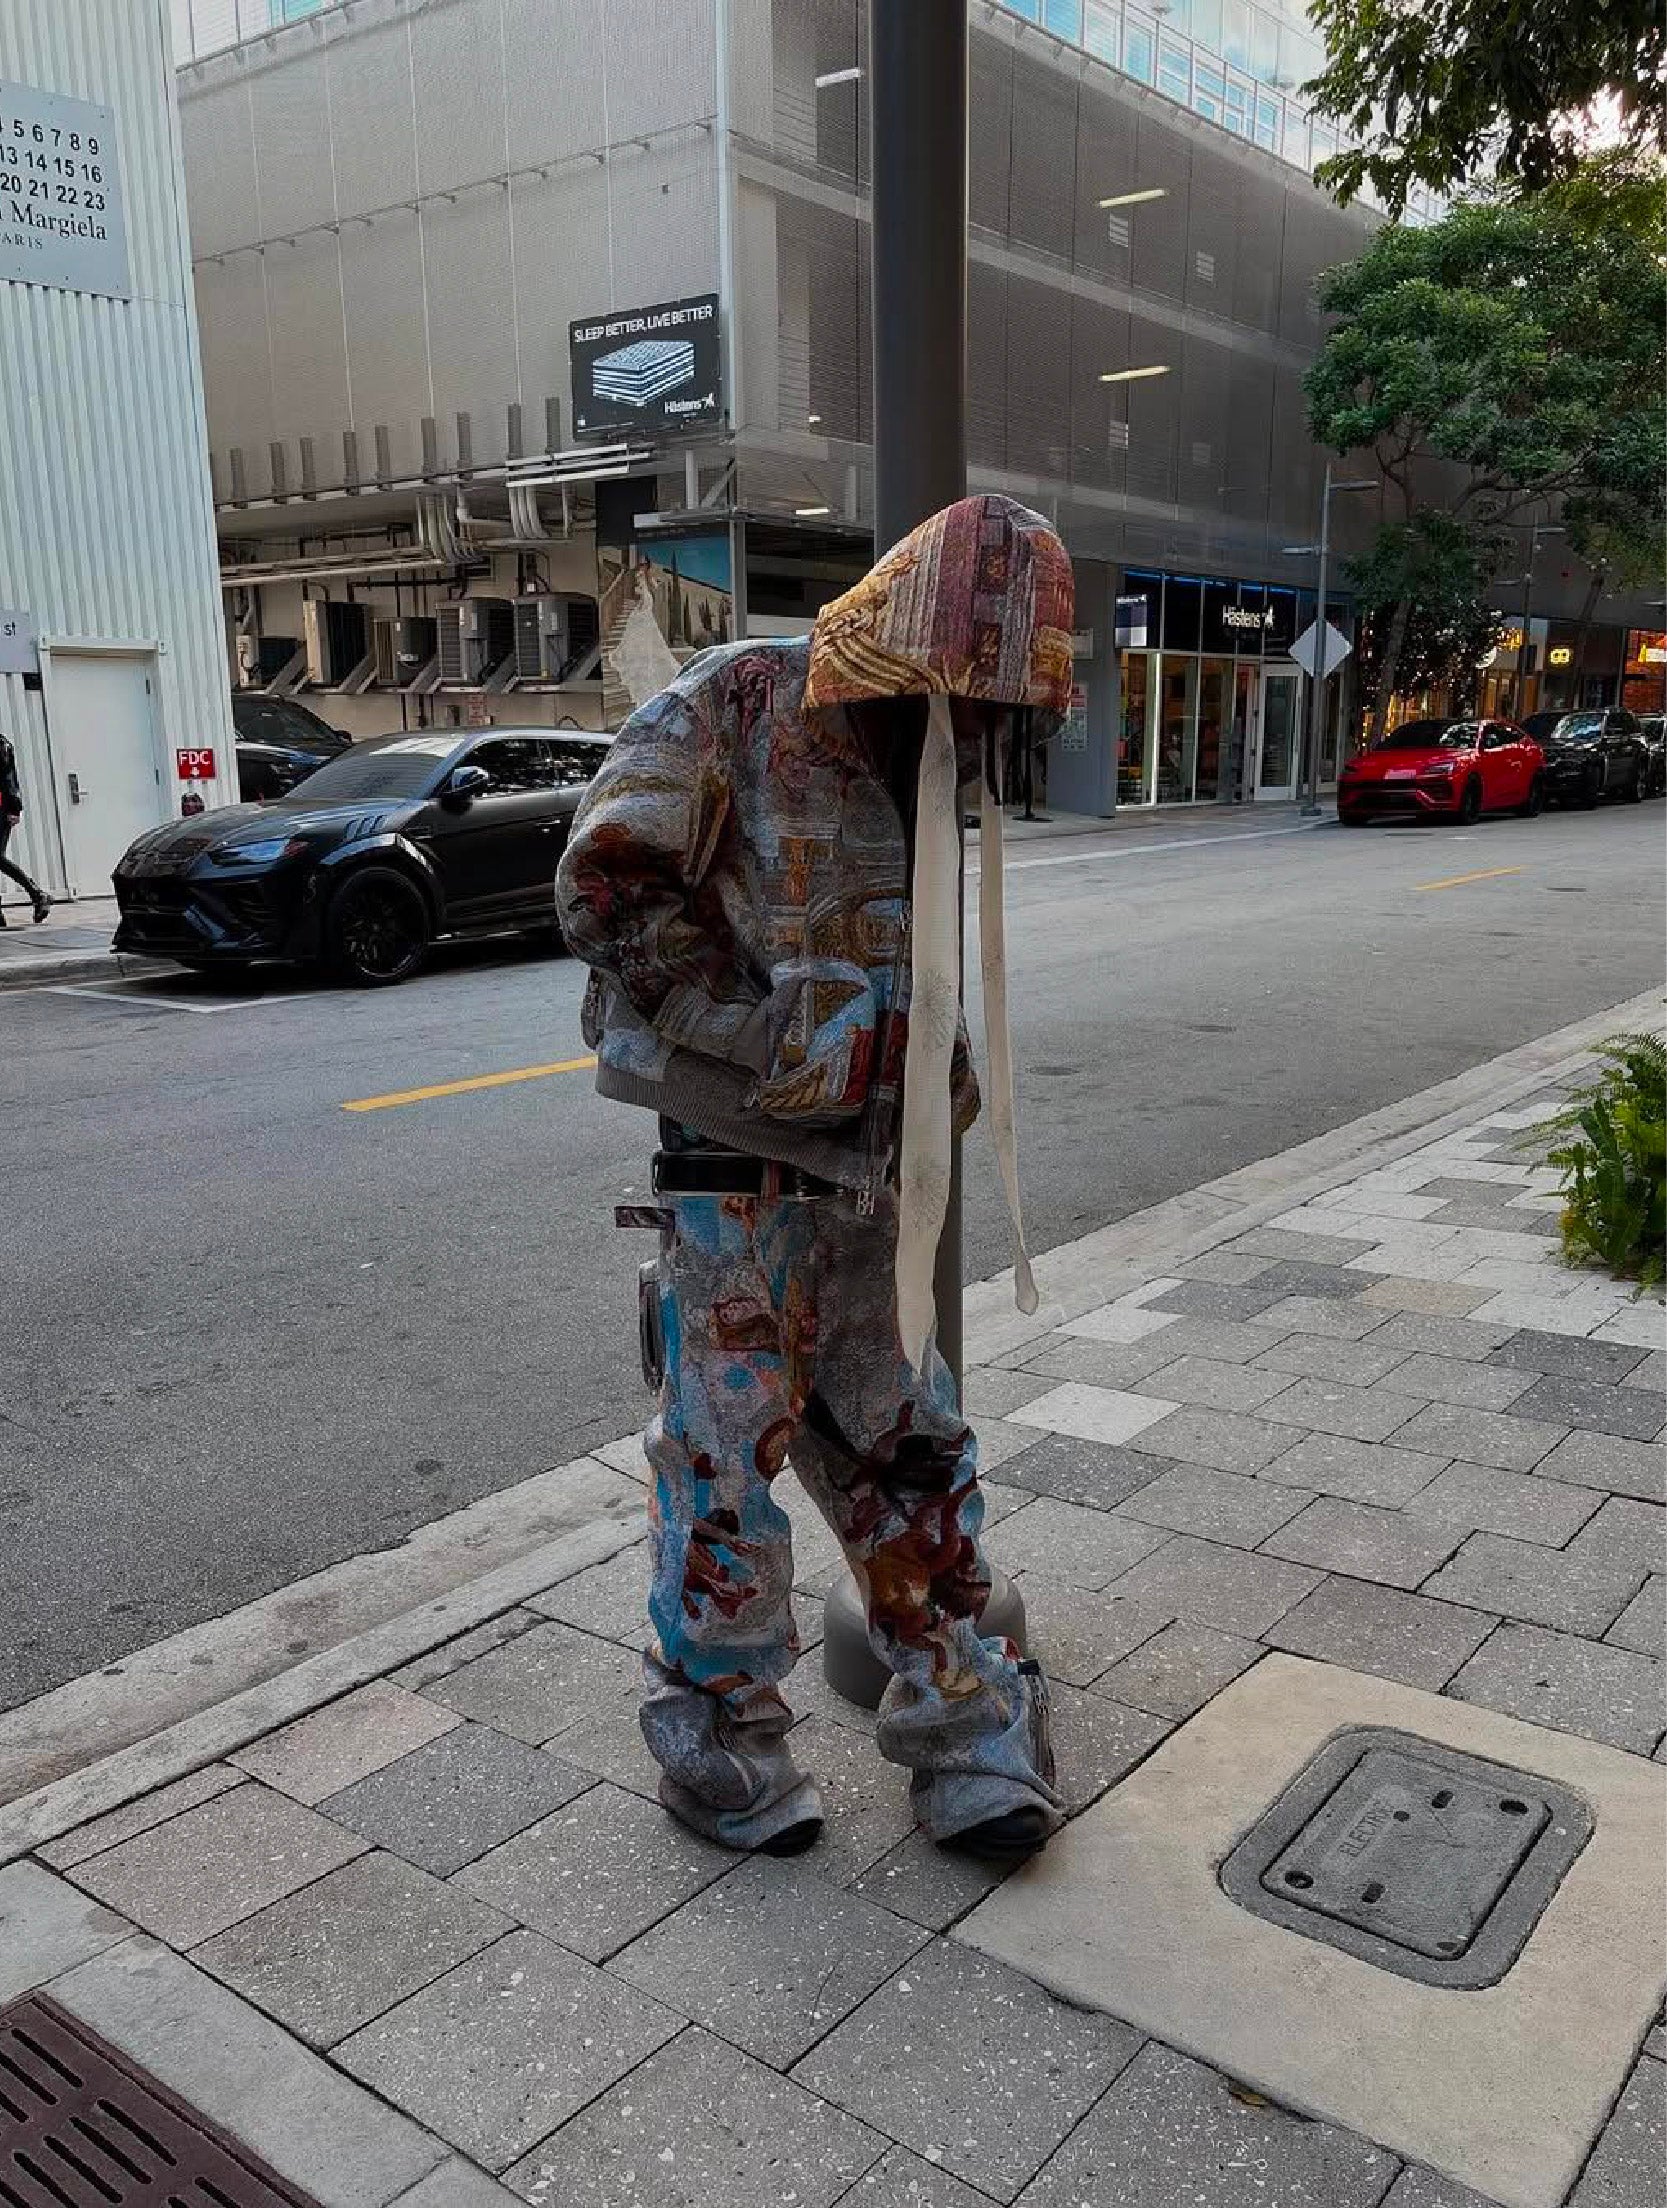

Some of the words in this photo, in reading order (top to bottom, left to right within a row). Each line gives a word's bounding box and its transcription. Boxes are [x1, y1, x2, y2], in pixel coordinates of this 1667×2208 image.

[14, 119, 25, 138] 5
[32, 124, 44, 142] 6
[50, 128, 61, 148] 7
[70, 132, 81, 152] 8
[88, 136, 100, 156] 9
[25, 149, 48, 172] 14
[53, 156, 75, 178] 15
[81, 163, 103, 184] 16
[0, 172, 22, 193] 20
[28, 178, 49, 200] 21
[55, 184, 79, 205] 22
[83, 190, 106, 212] 23
[10, 200, 108, 241] Margiela
[0, 231, 43, 250] ARIS
[574, 325, 605, 344] SLEEP
[647, 311, 671, 330] LIVE
[672, 304, 713, 325] BETTER
[4, 621, 16, 637] st
[178, 750, 211, 766] FDC
